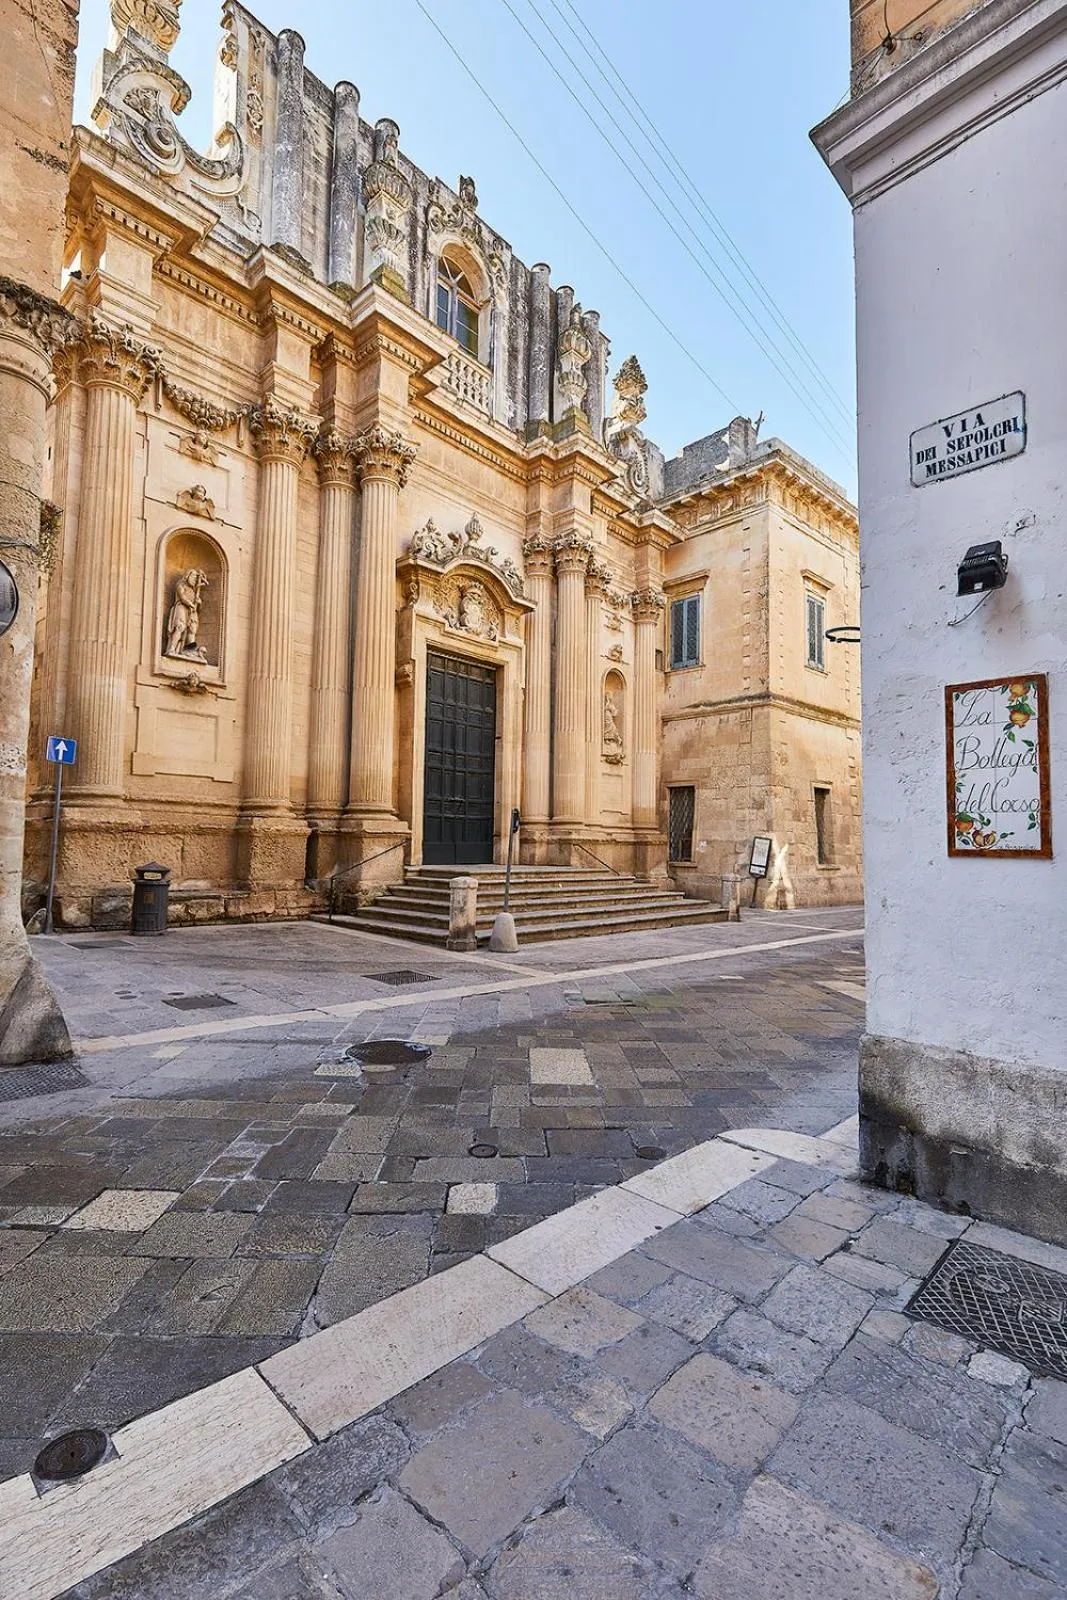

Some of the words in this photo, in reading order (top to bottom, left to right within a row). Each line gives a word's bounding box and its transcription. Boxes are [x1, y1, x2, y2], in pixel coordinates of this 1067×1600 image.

[915, 446, 937, 465] DEI
[946, 416, 1019, 454] SEPOLCRI
[942, 413, 985, 438] VIA
[925, 439, 1006, 478] MESSAPICI
[955, 691, 992, 728] La
[957, 782, 990, 813] del
[991, 777, 1040, 813] Corso
